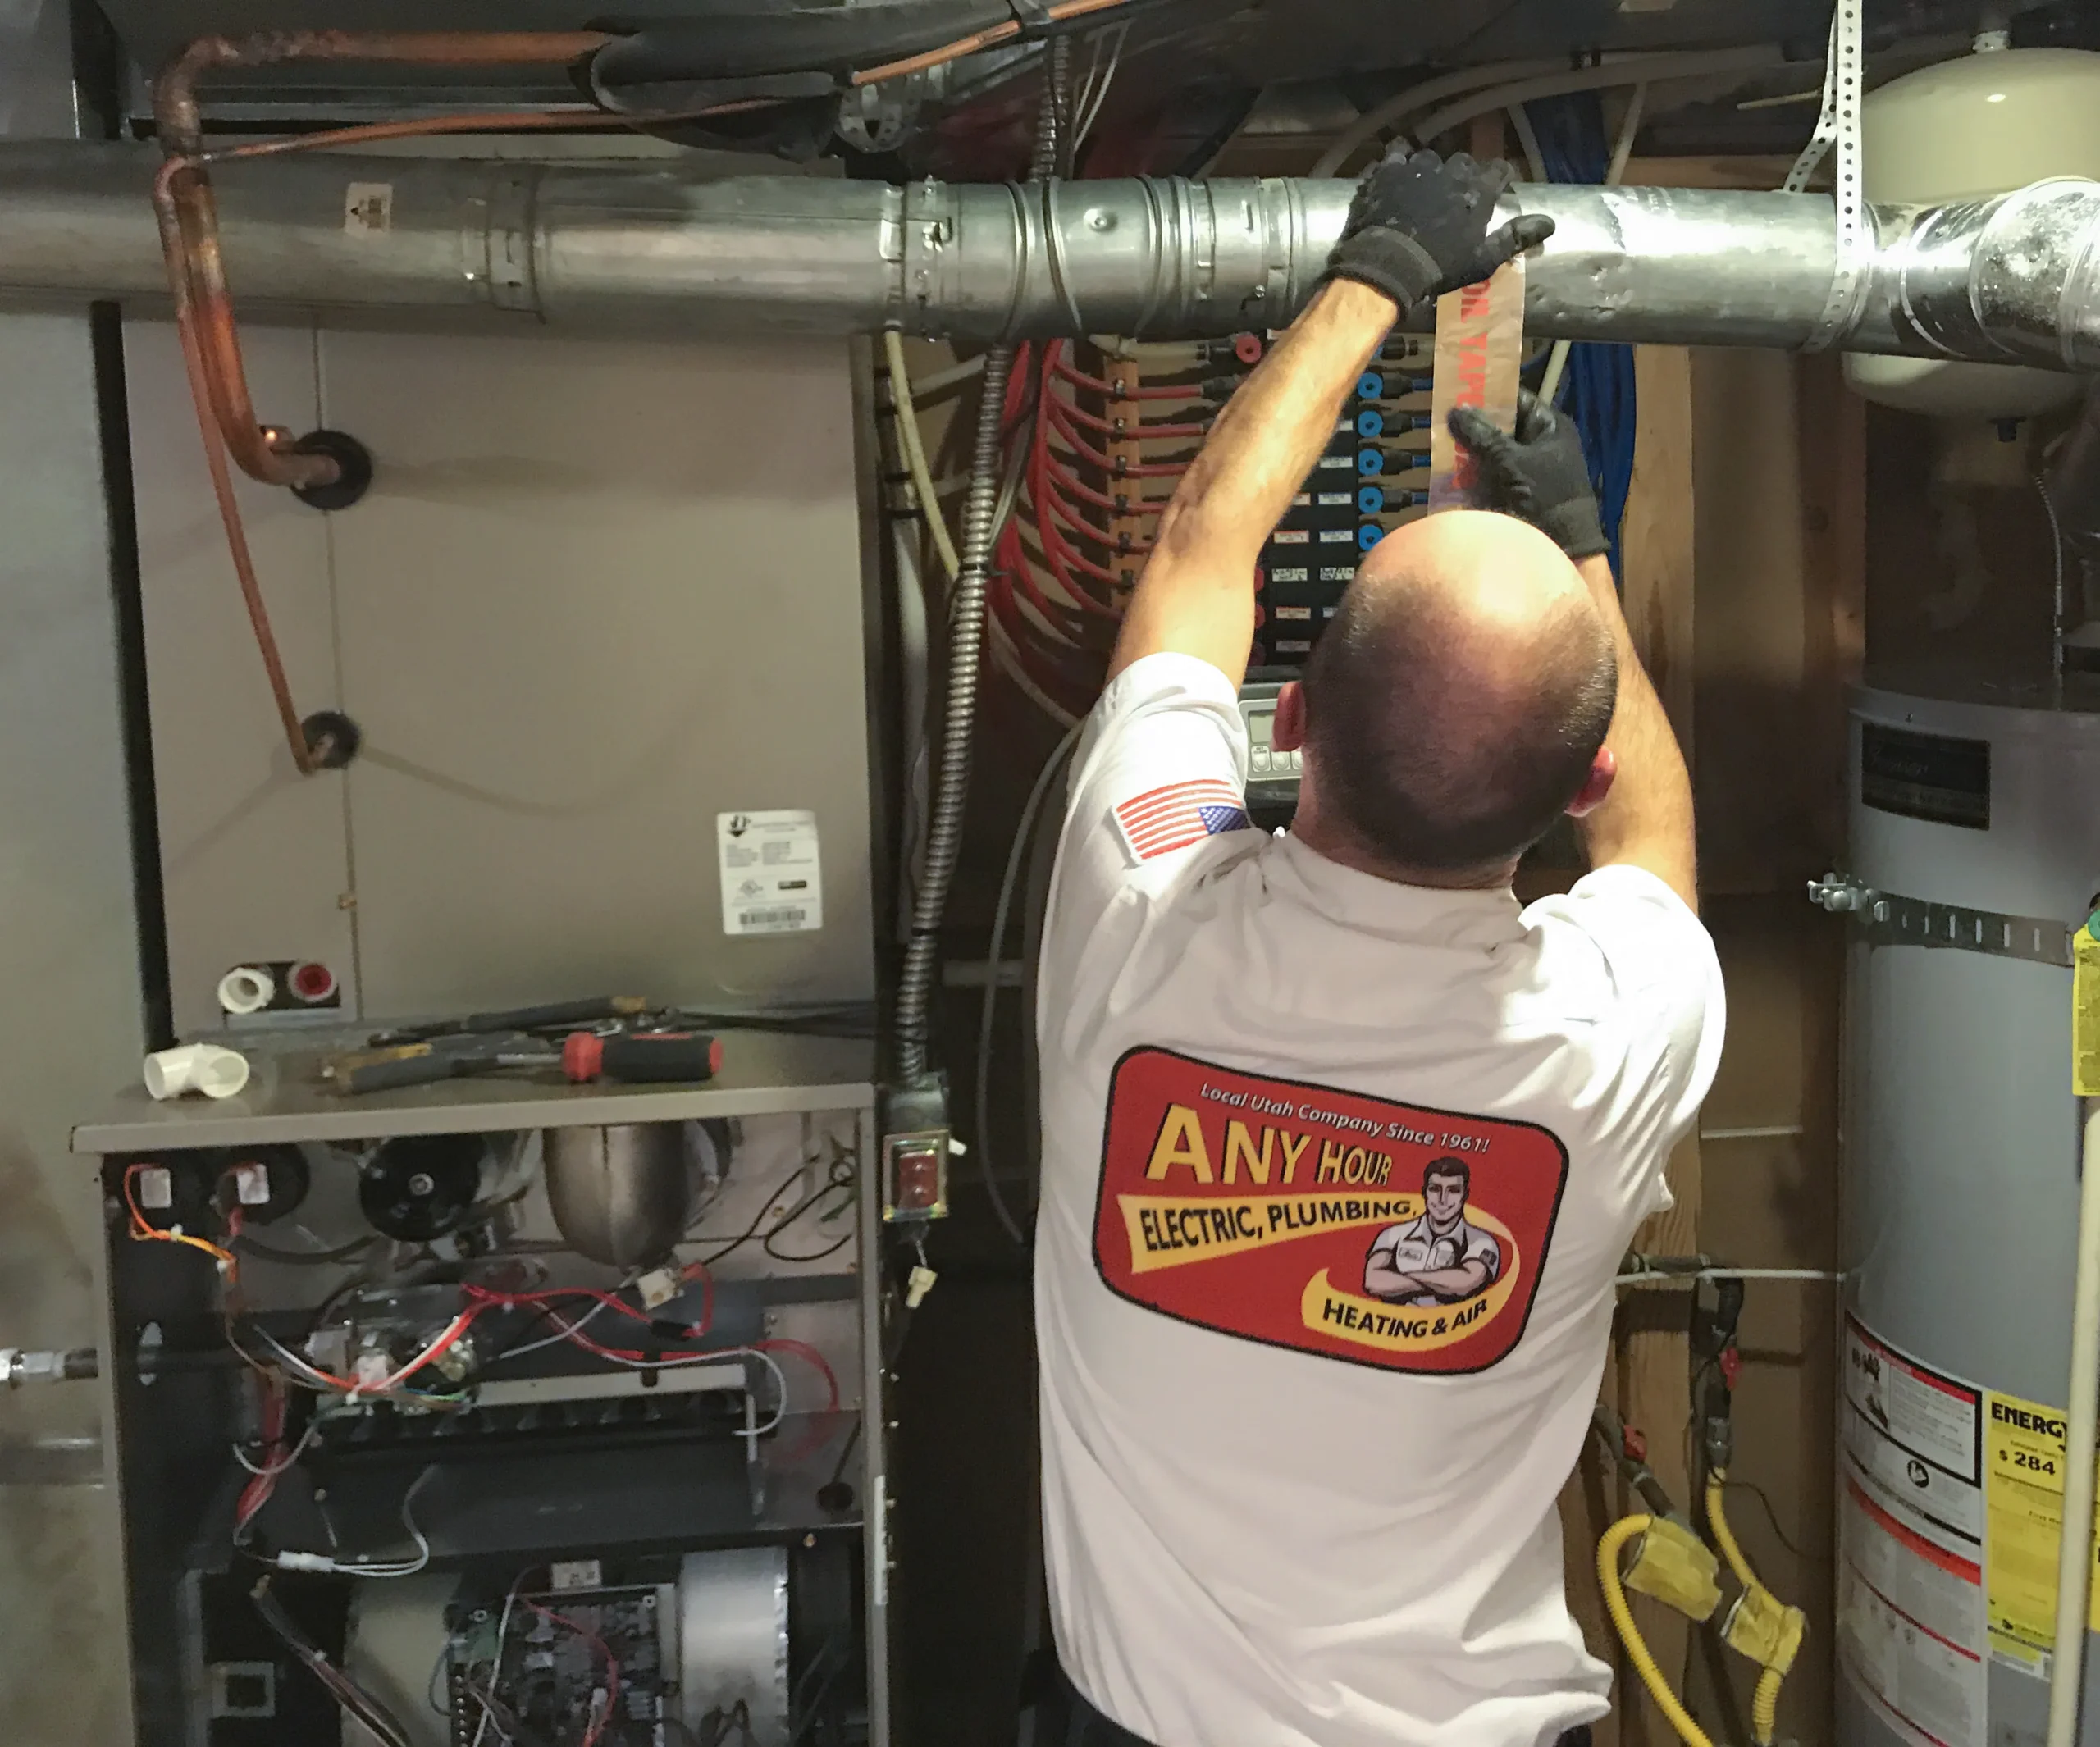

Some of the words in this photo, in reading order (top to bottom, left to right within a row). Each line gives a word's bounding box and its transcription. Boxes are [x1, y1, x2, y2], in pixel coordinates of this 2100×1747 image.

[1460, 279, 1491, 323] OIL
[1457, 332, 1487, 408] TAPE
[1201, 1082, 1247, 1107] Local
[1251, 1096, 1294, 1118] Utah
[1297, 1104, 1384, 1138] Company
[1386, 1122, 1434, 1147] Since
[1440, 1131, 1491, 1153] 1961!
[1146, 1103, 1312, 1184] ANY
[1315, 1138, 1394, 1187] HOUR
[1140, 1206, 1265, 1252] ELECTRIC,
[1268, 1199, 1418, 1232] PLUMBING,
[1322, 1298, 1427, 1338] HEATING
[1431, 1317, 1449, 1336] &
[1450, 1298, 1489, 1330] AIR
[2014, 1451, 2056, 1476] 284
